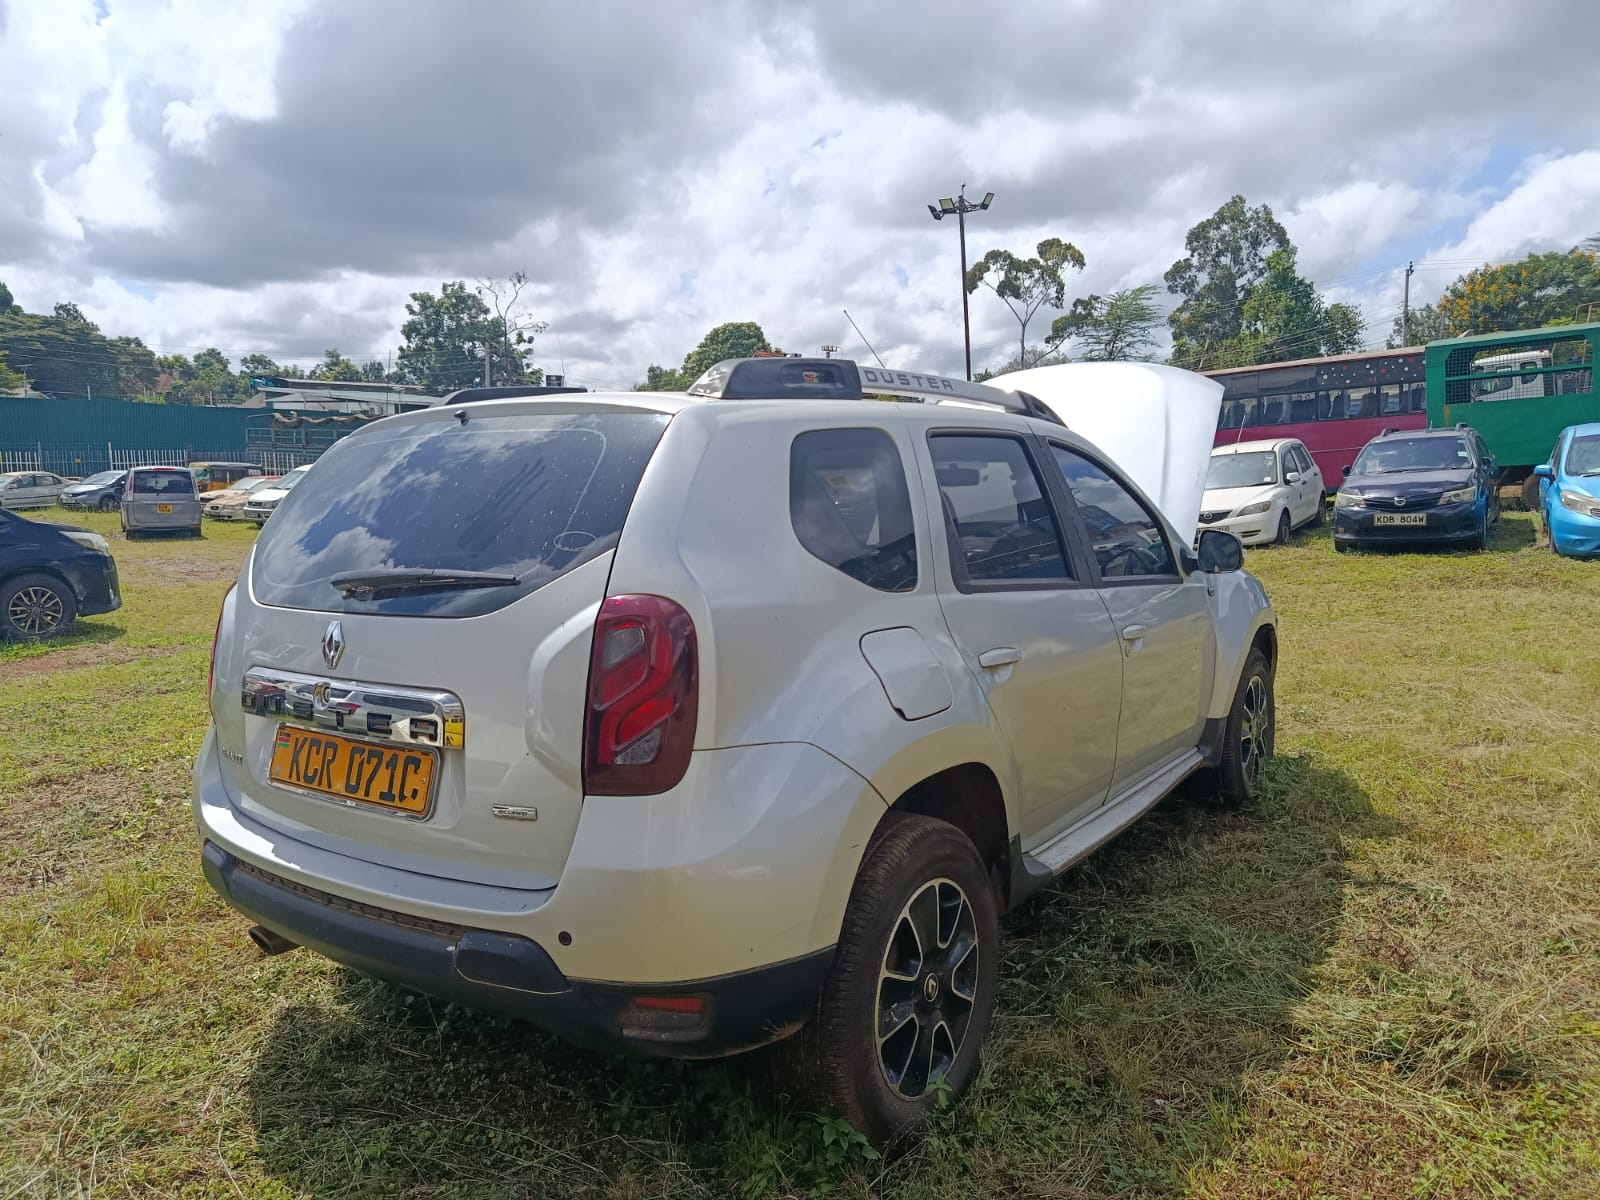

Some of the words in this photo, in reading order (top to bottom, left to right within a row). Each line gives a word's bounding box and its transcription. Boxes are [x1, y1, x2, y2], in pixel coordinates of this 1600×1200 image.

[863, 369, 954, 392] DUSTER
[241, 690, 439, 743] DUSTER
[289, 736, 338, 789] KCR
